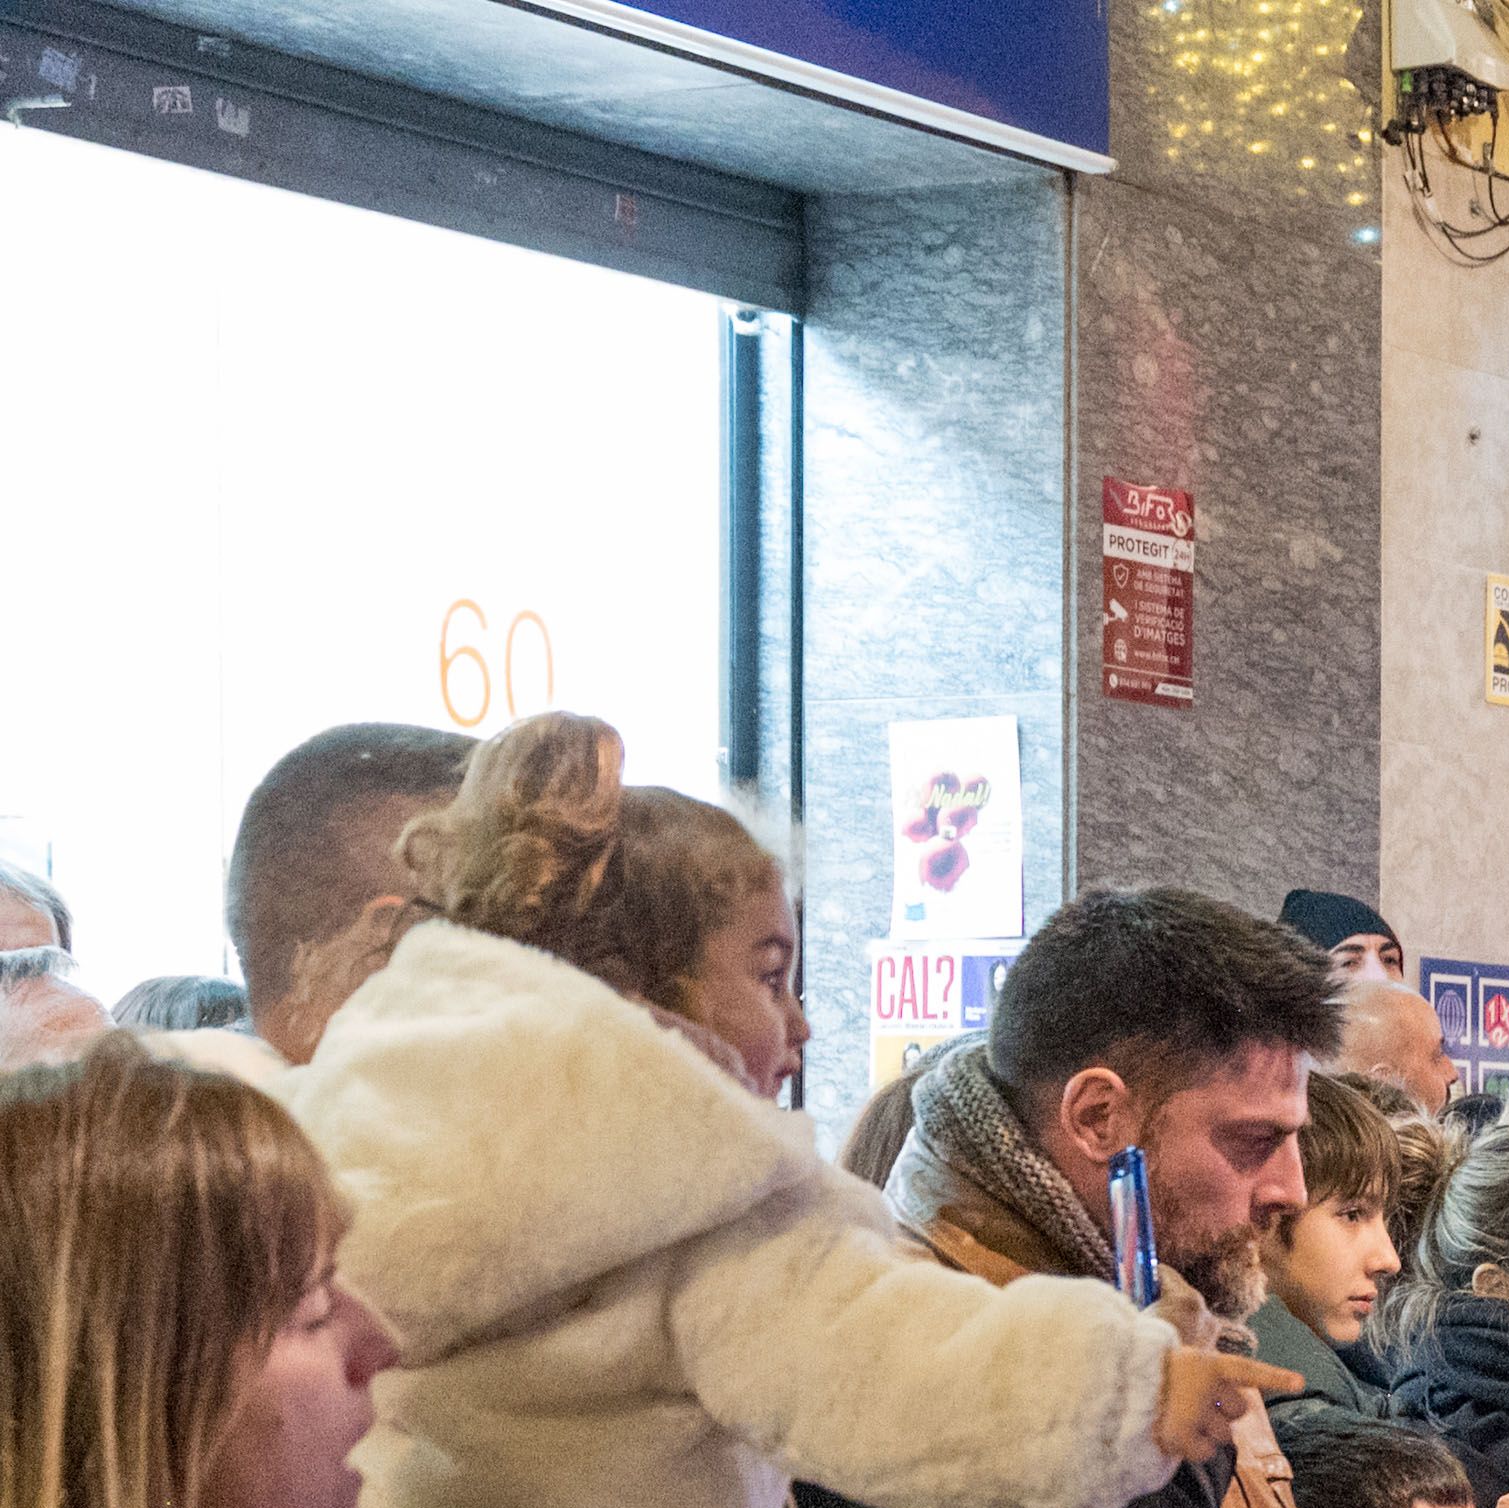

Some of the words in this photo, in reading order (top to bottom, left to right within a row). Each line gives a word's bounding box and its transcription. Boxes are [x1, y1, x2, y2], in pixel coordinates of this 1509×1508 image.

[1109, 534, 1169, 560] PROTEGIT
[1134, 625, 1186, 647] D'IMATGES
[876, 954, 954, 1020] CAL?
